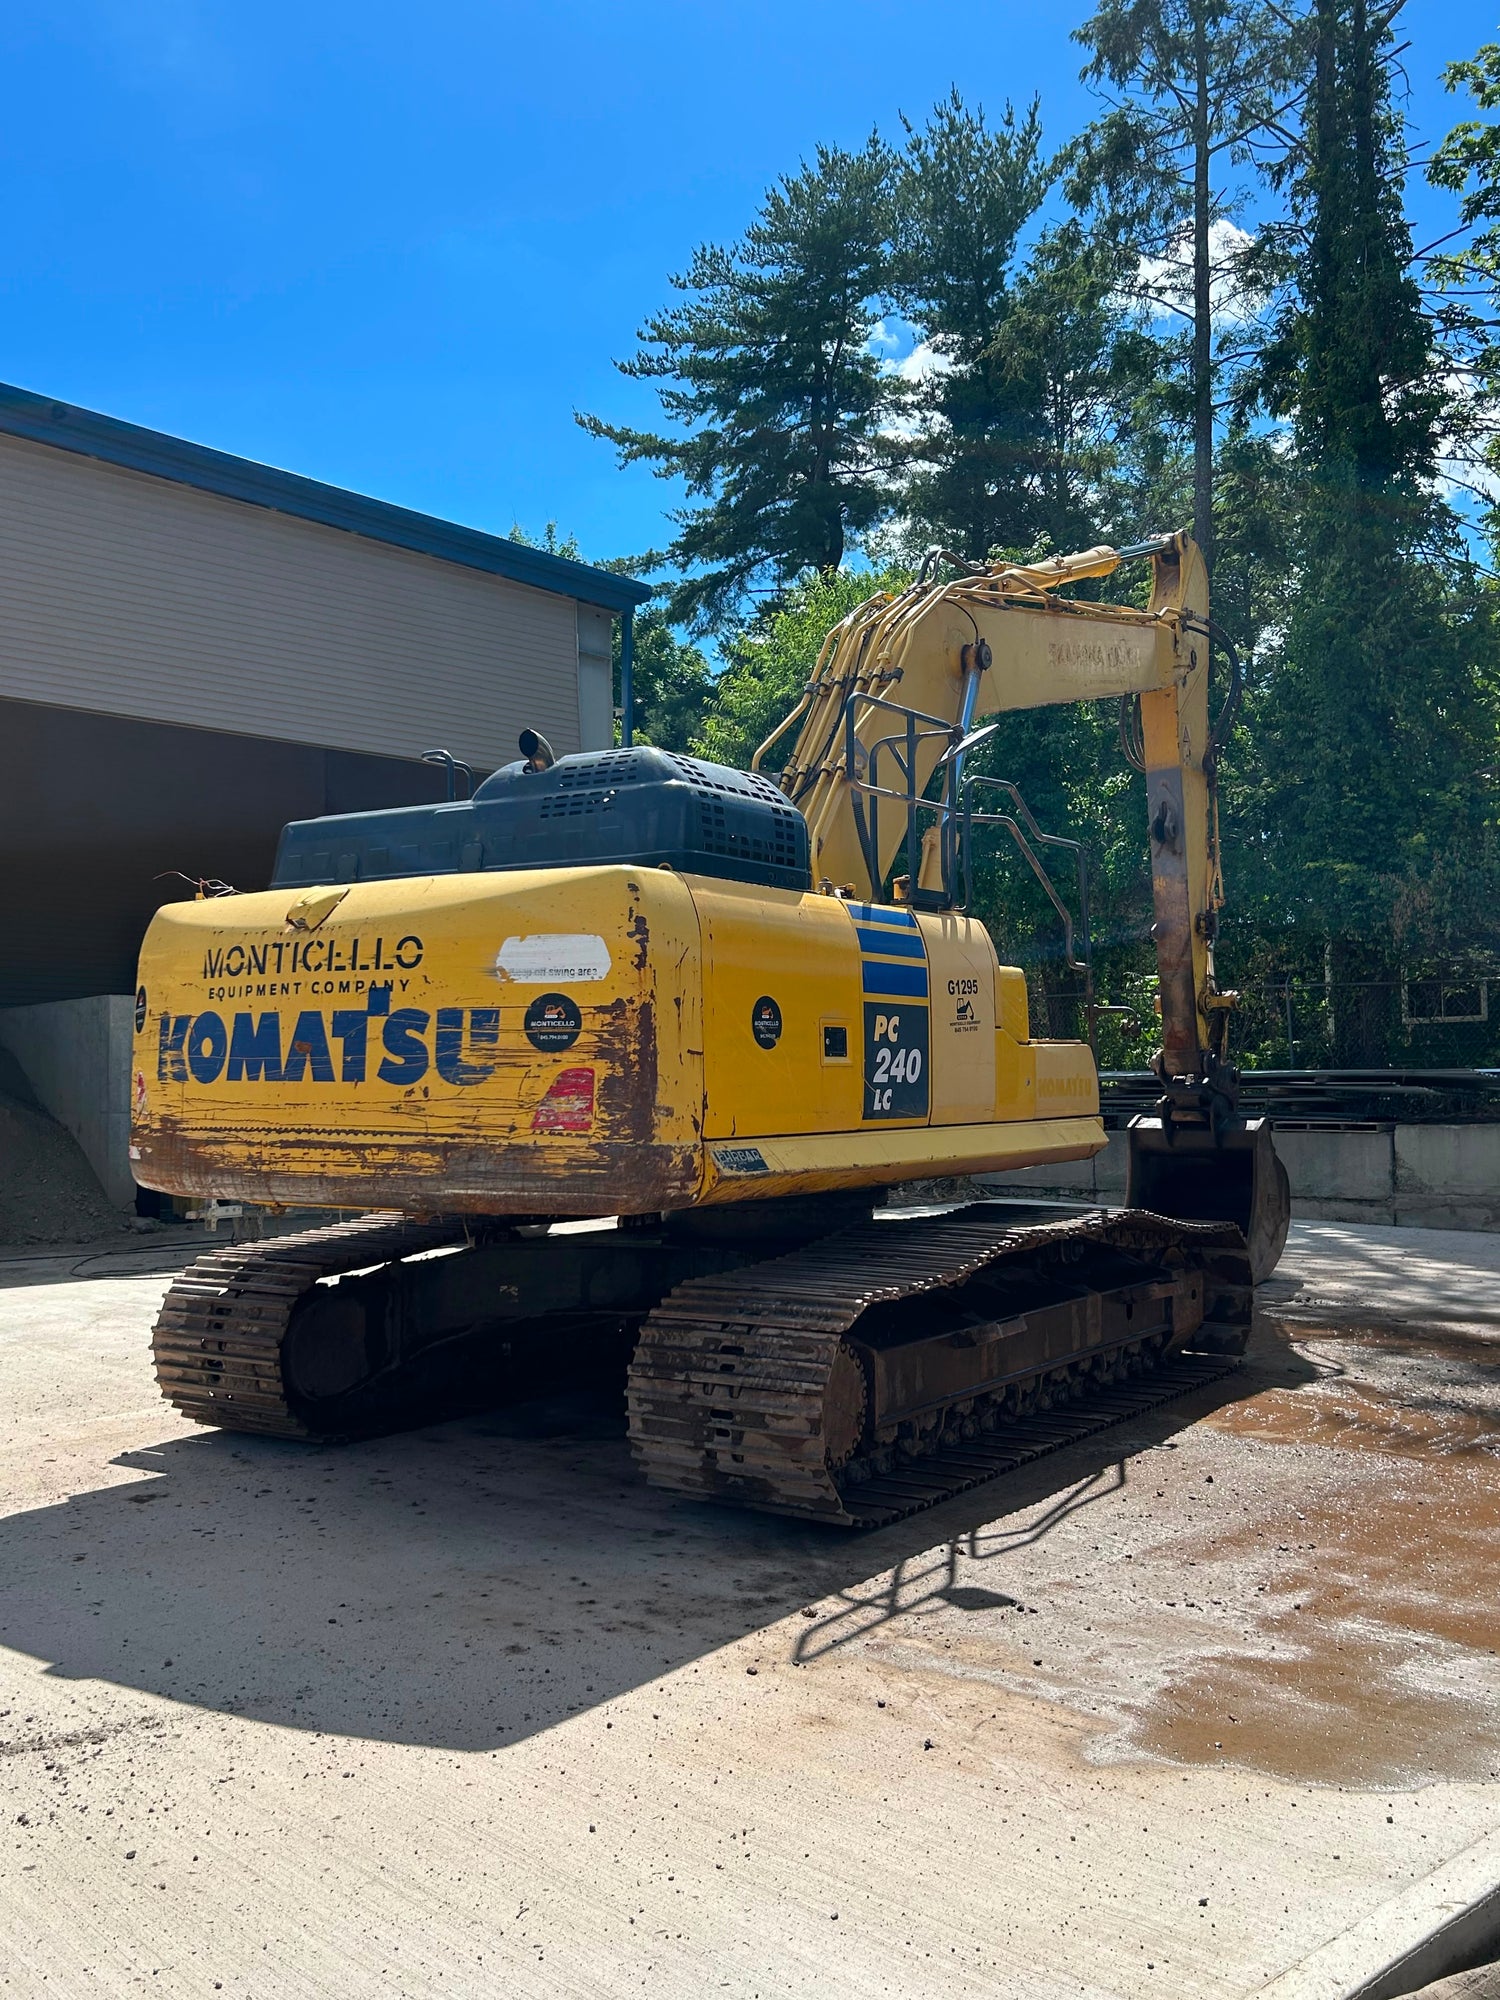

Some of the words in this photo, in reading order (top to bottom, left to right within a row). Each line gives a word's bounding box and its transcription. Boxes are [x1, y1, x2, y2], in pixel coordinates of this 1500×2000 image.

[202, 935, 424, 979] MONTICELLO
[577, 967, 598, 976] area
[208, 981, 302, 1001] EQUIPMENT
[311, 978, 410, 995] COMPANY
[947, 979, 979, 995] G1295
[157, 986, 501, 1086] KOMATSU
[873, 1014, 900, 1043] PC
[872, 1047, 922, 1084] 240
[873, 1088, 893, 1111] LC
